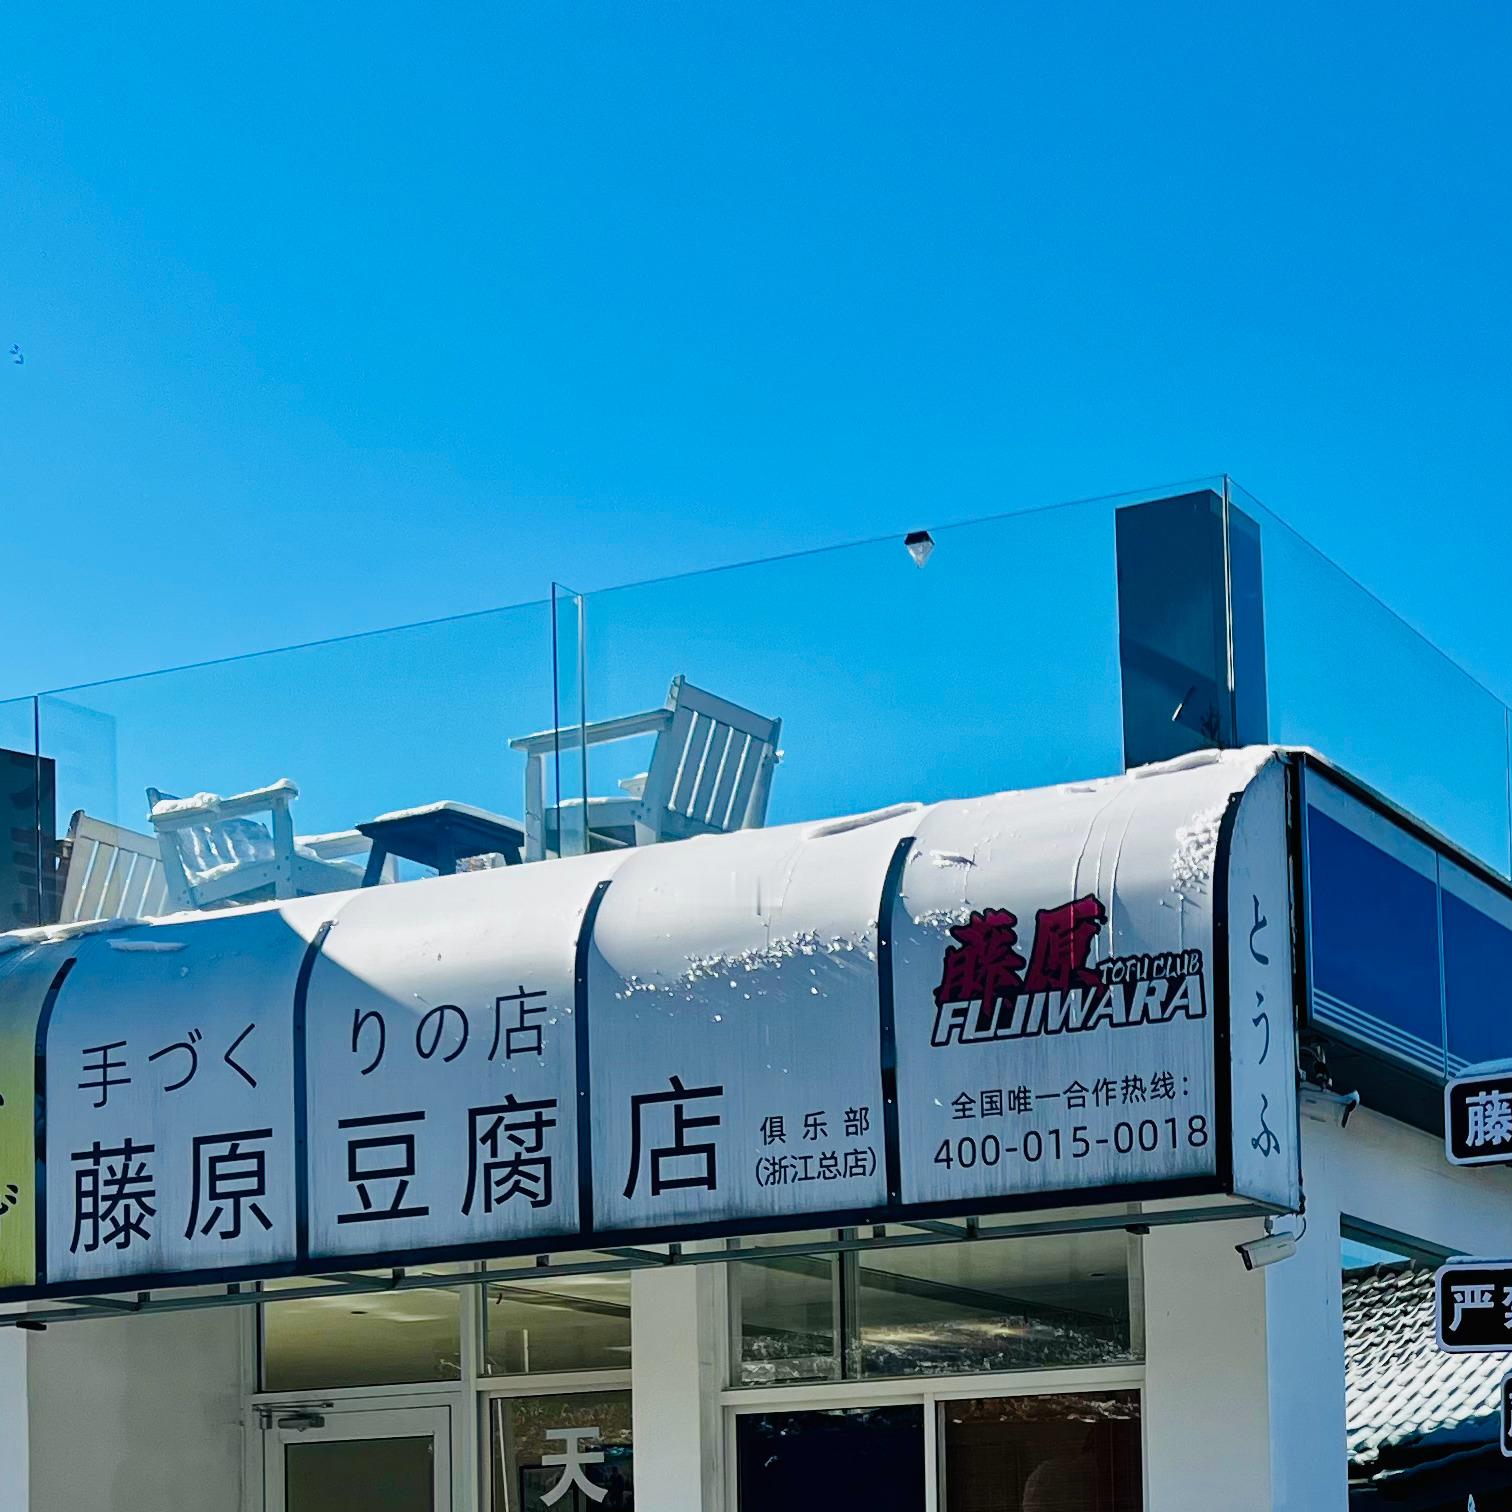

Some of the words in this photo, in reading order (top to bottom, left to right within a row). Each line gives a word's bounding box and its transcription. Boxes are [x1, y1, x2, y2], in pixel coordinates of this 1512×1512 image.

[1100, 959, 1148, 984] TOFU
[1153, 953, 1201, 978] CLUB
[934, 974, 1204, 1044] FUJIWARA
[1246, 893, 1282, 1158] とうふ
[759, 1106, 871, 1146] 俱乐部
[934, 1114, 1209, 1170] 400-015-0018
[755, 1146, 877, 1187] (浙江总店)
